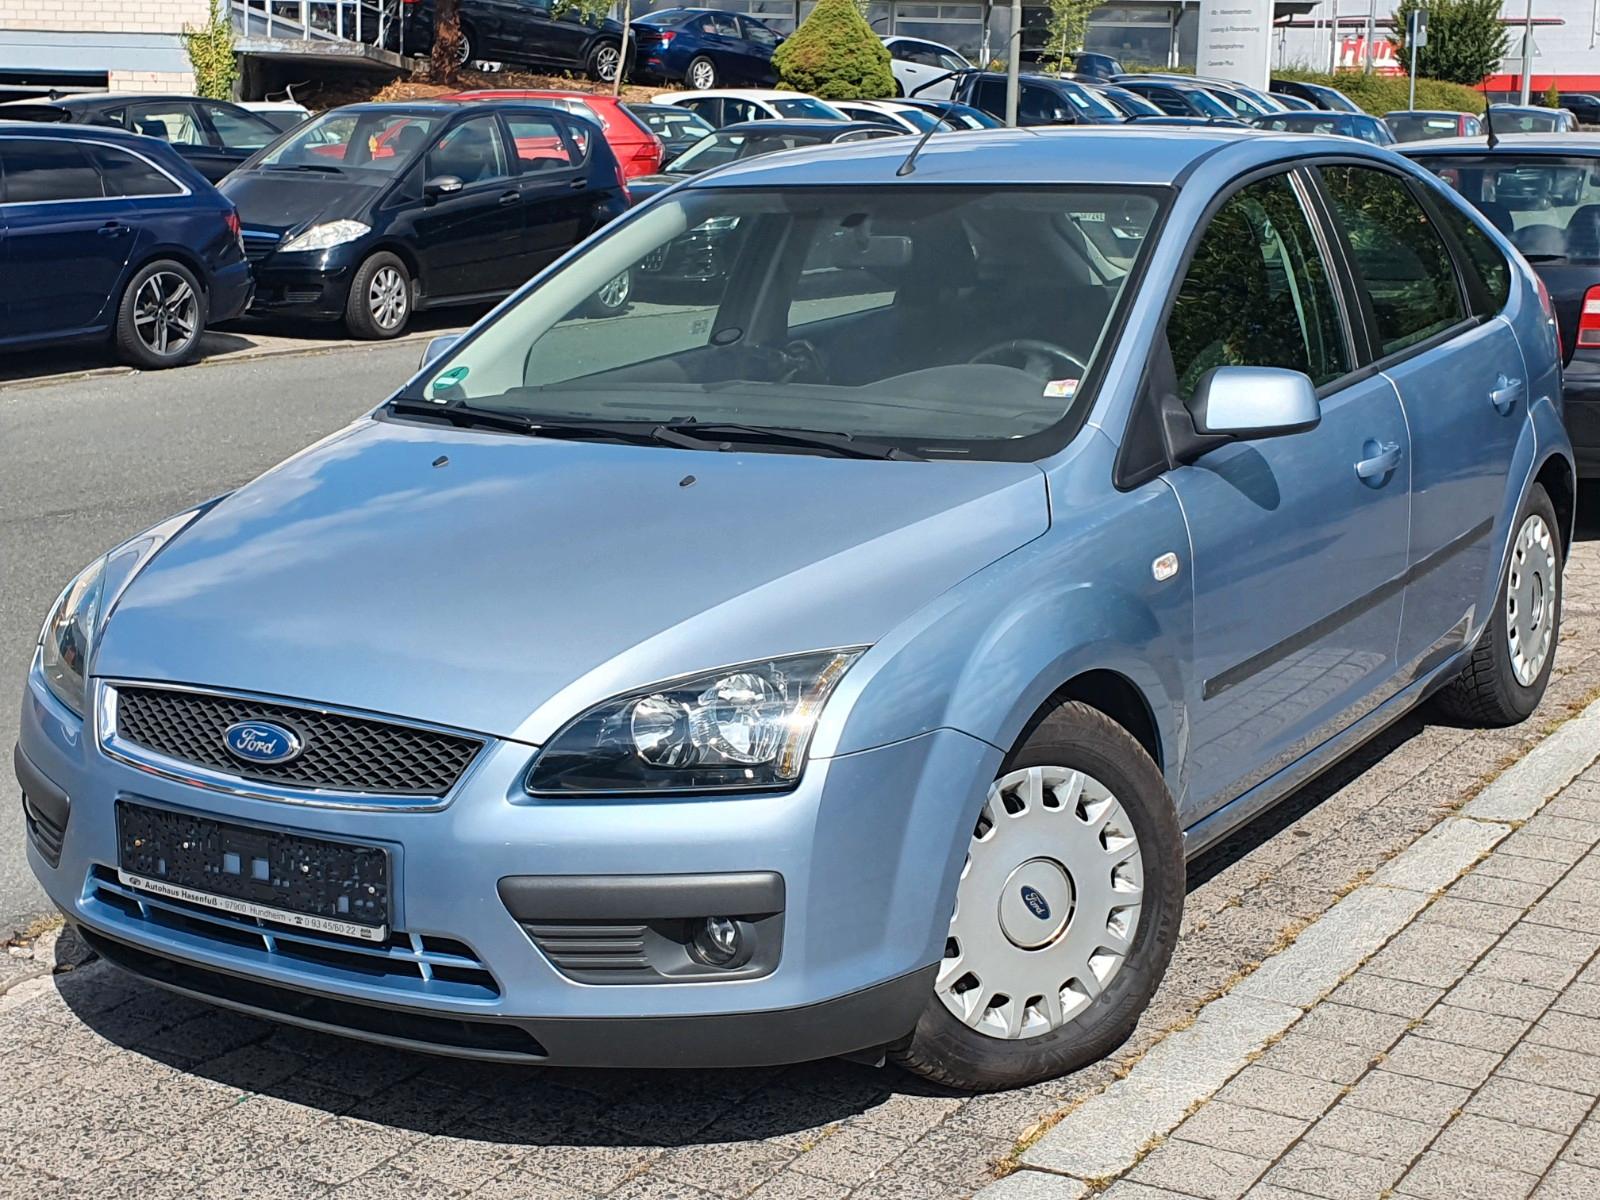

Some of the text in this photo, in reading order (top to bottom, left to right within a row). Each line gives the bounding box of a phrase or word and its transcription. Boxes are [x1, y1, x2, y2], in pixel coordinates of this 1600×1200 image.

[236, 728, 278, 754] Ford
[144, 881, 179, 897] Autohaus
[181, 890, 217, 906] Hasenfuß
[1025, 892, 1046, 914] Ford
